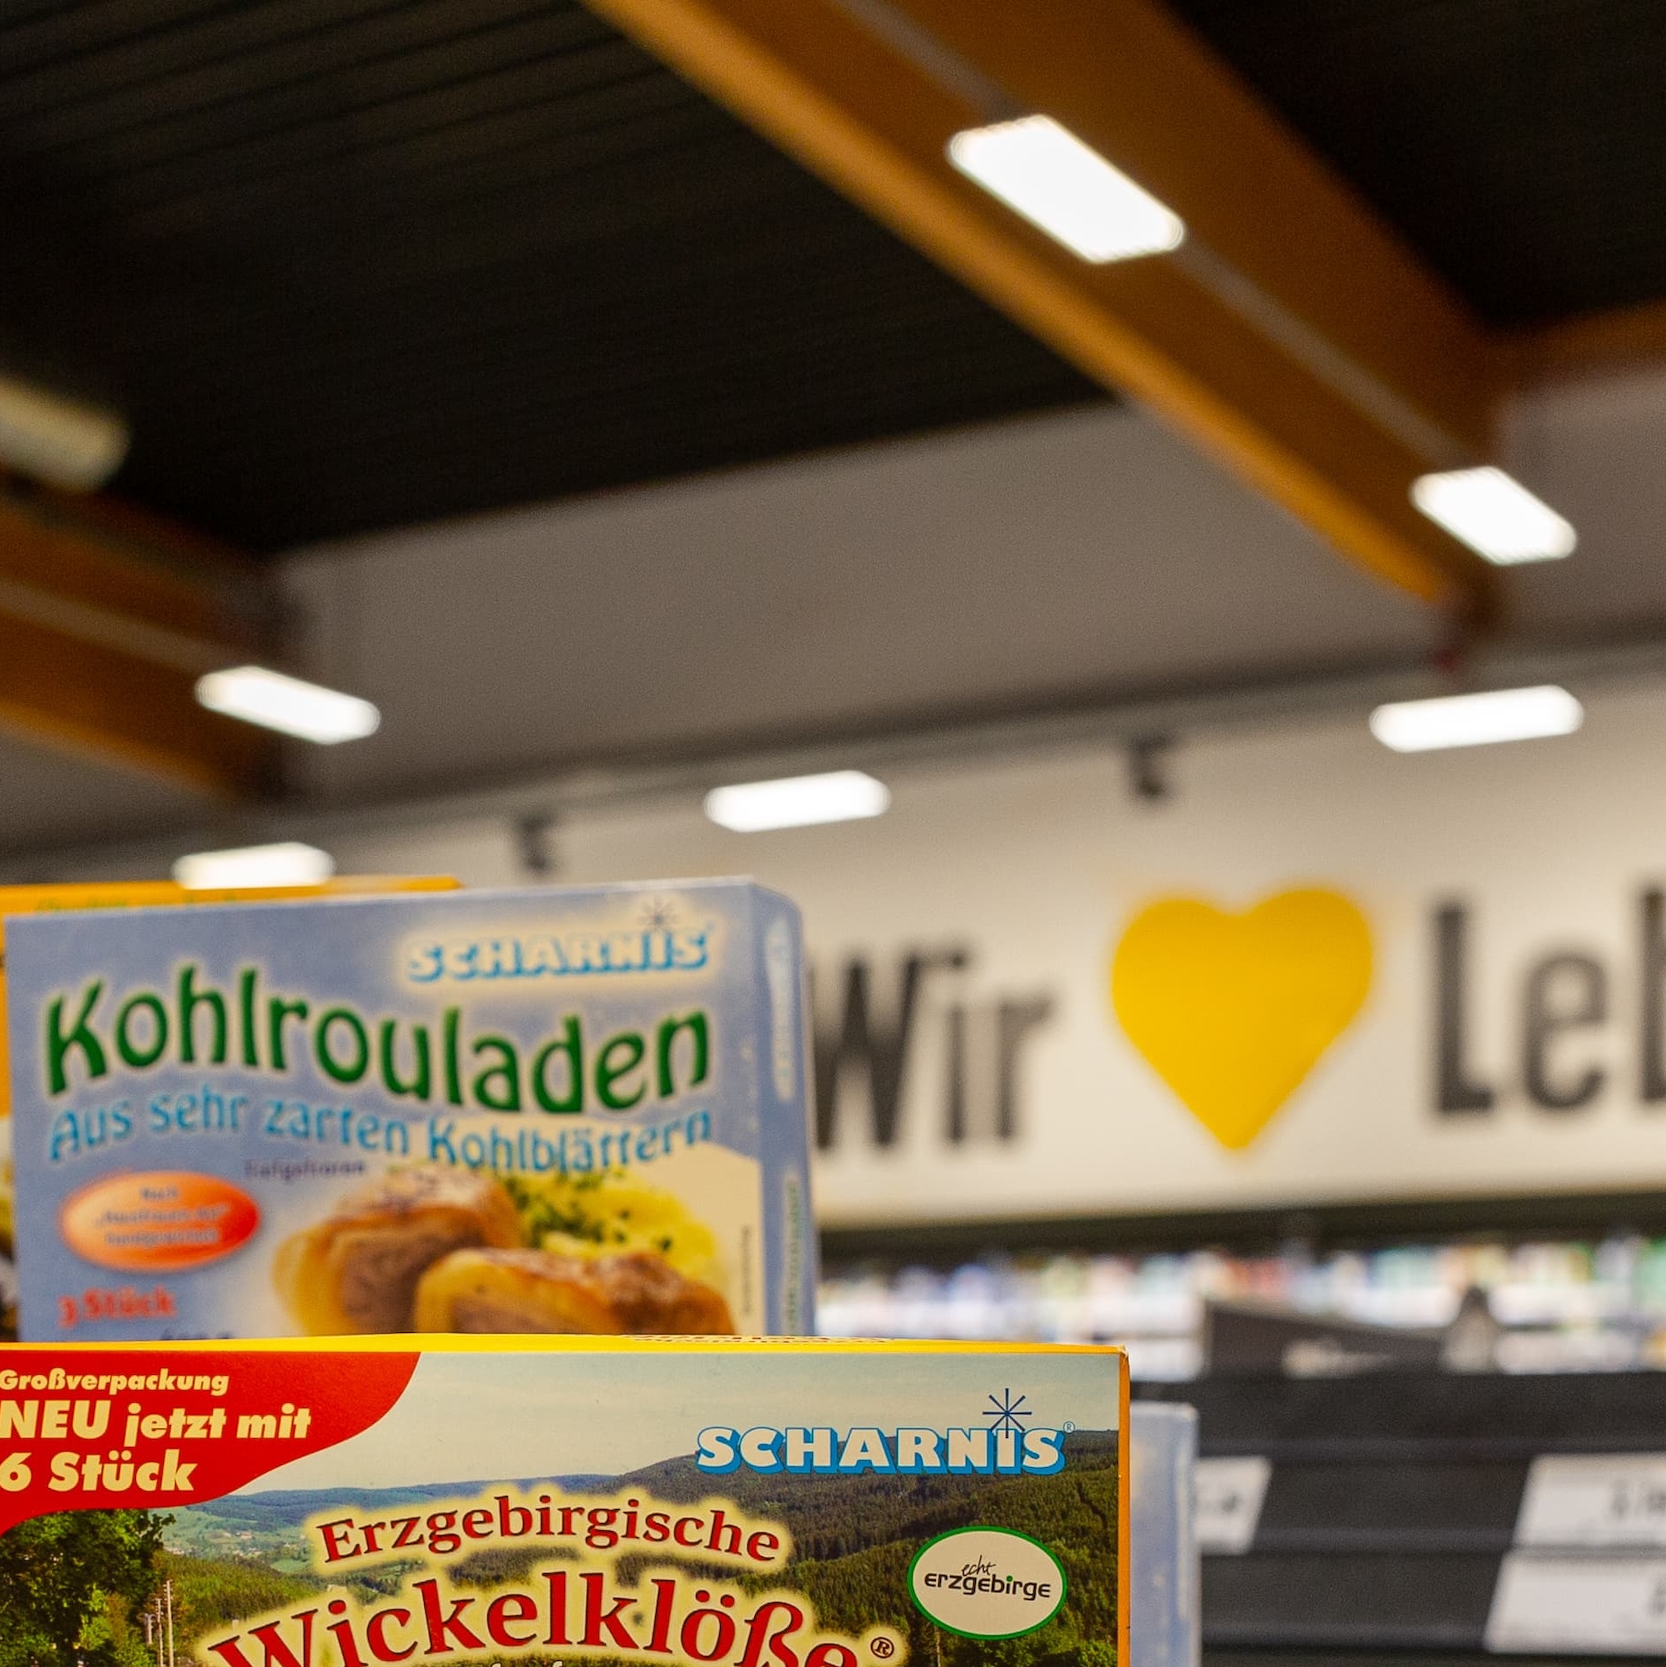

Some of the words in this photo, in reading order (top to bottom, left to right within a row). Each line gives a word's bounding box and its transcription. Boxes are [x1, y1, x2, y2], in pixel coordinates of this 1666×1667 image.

[406, 928, 711, 982] SCHARNIS
[48, 964, 710, 1114] Kohlrouladen
[810, 945, 1055, 1150] Wir
[50, 1097, 131, 1161] Aus
[150, 1083, 245, 1134] sehr
[265, 1099, 410, 1155] zarten
[428, 1110, 712, 1174] Kohlblättern
[124, 1402, 226, 1447] jetzt
[236, 1402, 312, 1439] mit
[696, 1425, 1066, 1475] SCHARNIS
[48, 1449, 197, 1491] Stück
[316, 1496, 780, 1563] Erzgebirgische
[924, 1572, 1051, 1601] erzgebirge
[962, 1555, 996, 1577] echt
